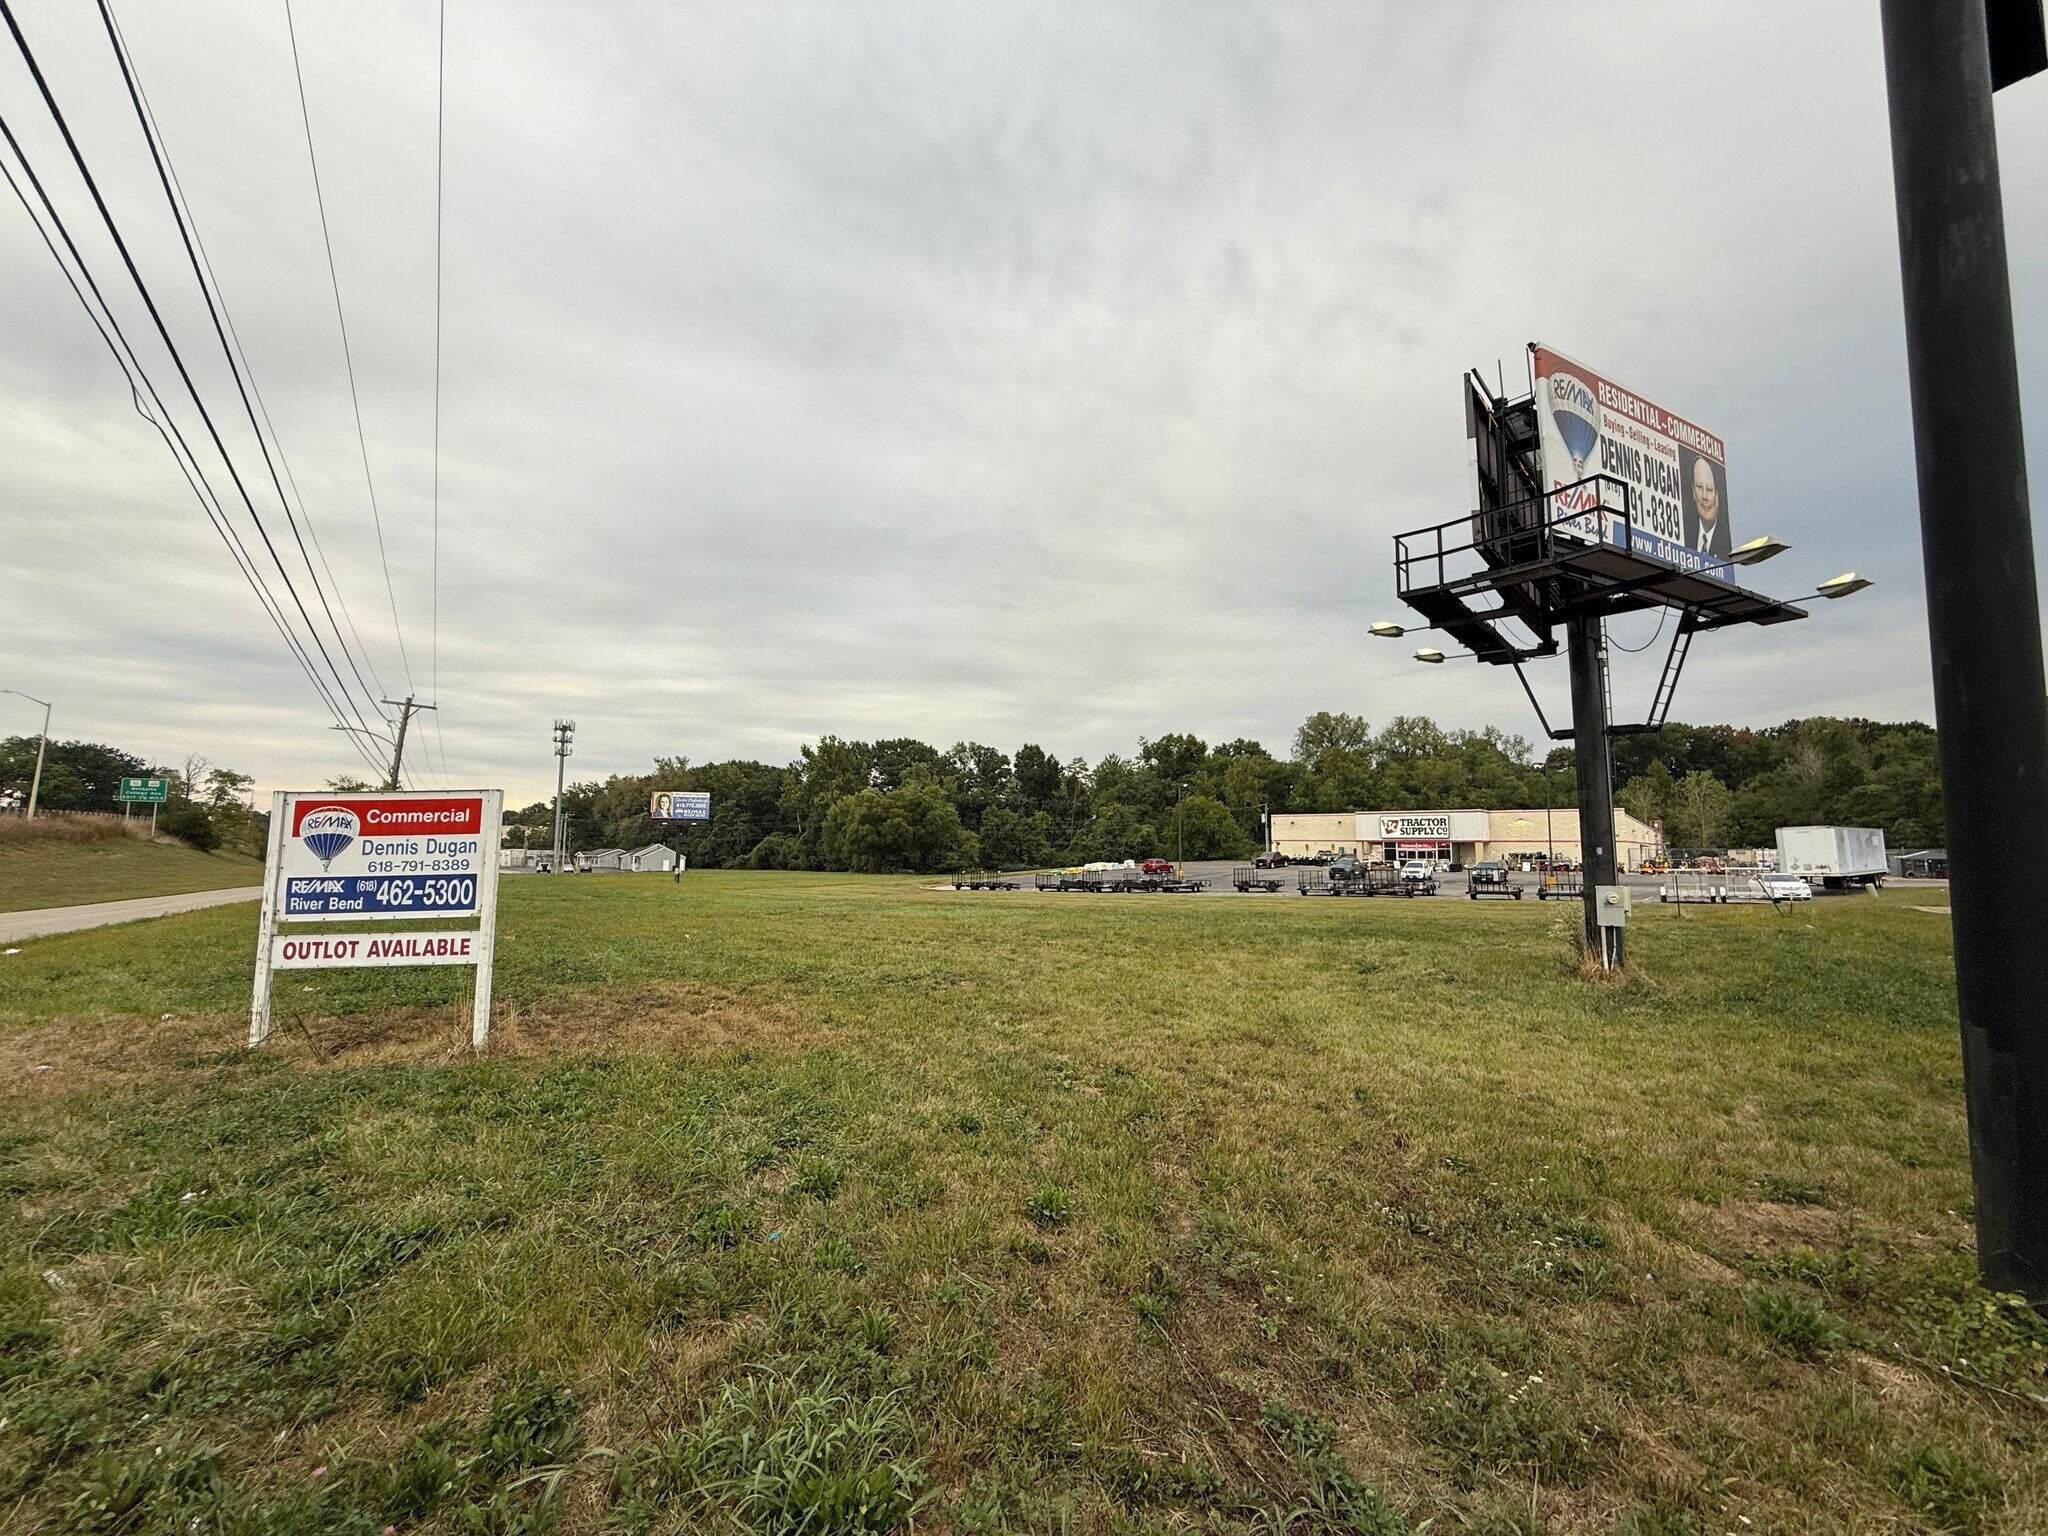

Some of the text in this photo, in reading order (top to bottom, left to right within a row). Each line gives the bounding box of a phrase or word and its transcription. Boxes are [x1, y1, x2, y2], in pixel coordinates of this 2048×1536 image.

[1553, 379, 1594, 416] RE/MAX
[1600, 433, 1681, 501] DENNIS DUGAN
[1630, 486, 1680, 541] 91-8389
[307, 814, 353, 830] RE/MAX
[366, 808, 470, 824] Commercial
[1400, 818, 1447, 827] TRACTOR
[1400, 827, 1435, 836] SUPPLY
[361, 838, 478, 858] Dennis Dugan
[368, 859, 470, 873] 618-791-8389
[291, 880, 345, 894] RE/MAX
[356, 879, 473, 906] (618) 462-5300
[290, 896, 363, 911] River Bend
[282, 938, 471, 960] OUTLOT AVAILABLE
